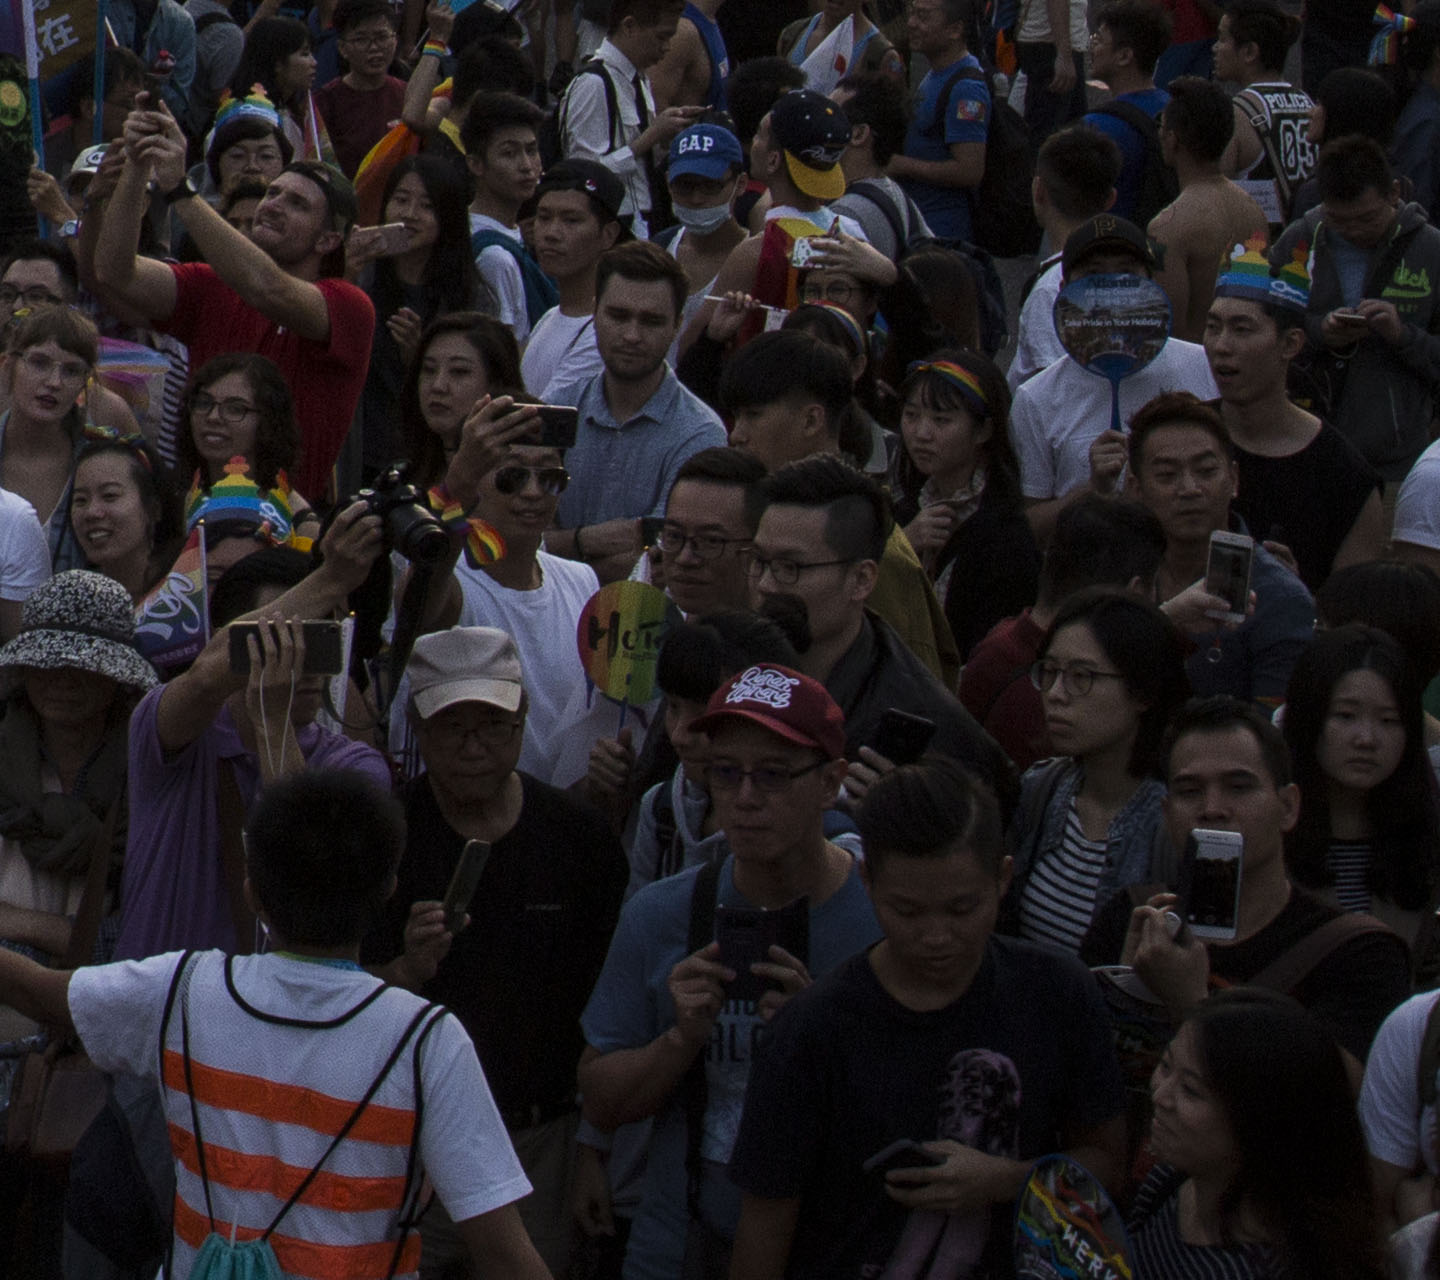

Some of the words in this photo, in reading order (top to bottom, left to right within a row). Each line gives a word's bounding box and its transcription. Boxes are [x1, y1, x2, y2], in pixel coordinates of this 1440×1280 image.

[677, 134, 713, 155] GAP
[1064, 319, 1081, 327] Take
[1082, 318, 1104, 327] Pride
[1105, 319, 1112, 327] in
[1113, 319, 1130, 327] Your
[1131, 318, 1162, 329] Holiday
